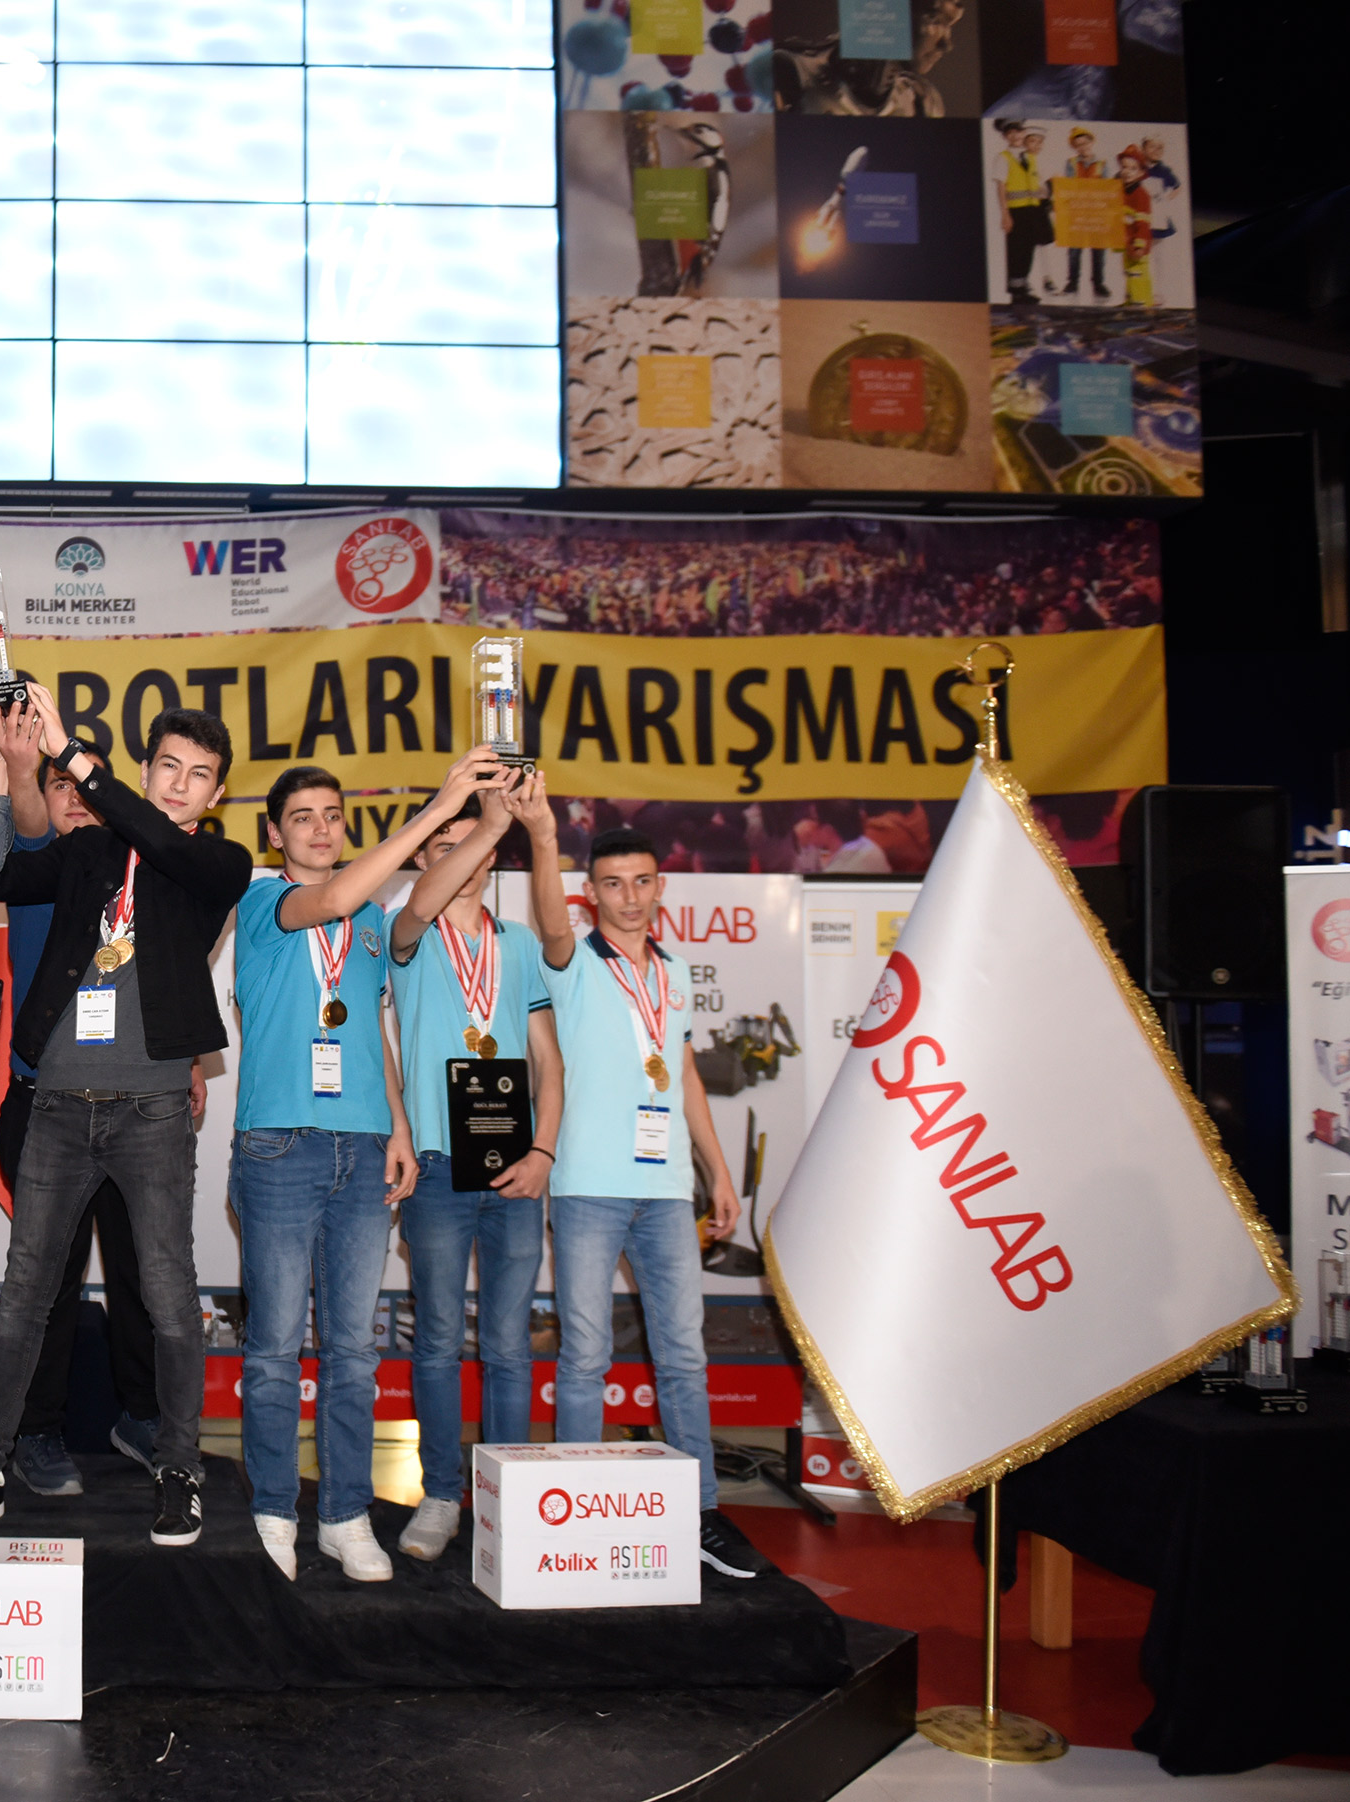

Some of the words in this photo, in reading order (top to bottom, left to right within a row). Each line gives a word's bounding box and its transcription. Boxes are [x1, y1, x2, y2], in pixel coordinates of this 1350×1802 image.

[341, 519, 427, 556] SANLAB
[183, 537, 287, 576] WER
[231, 577, 261, 586] World
[54, 582, 106, 597] KONYA
[231, 586, 289, 597] Educational
[25, 598, 66, 612] BİLİM
[70, 598, 136, 612] MERKEZİ
[231, 597, 260, 607] Robot
[231, 606, 270, 617] Contest
[25, 615, 80, 624] SCIENCE
[86, 615, 136, 624] CENTER
[871, 1035, 1074, 1312] SANLAB
[575, 1492, 665, 1518] SANLAB
[9, 1542, 64, 1551] ASTEM
[537, 1553, 599, 1572] Abilix
[611, 1545, 667, 1569] ASTEM
